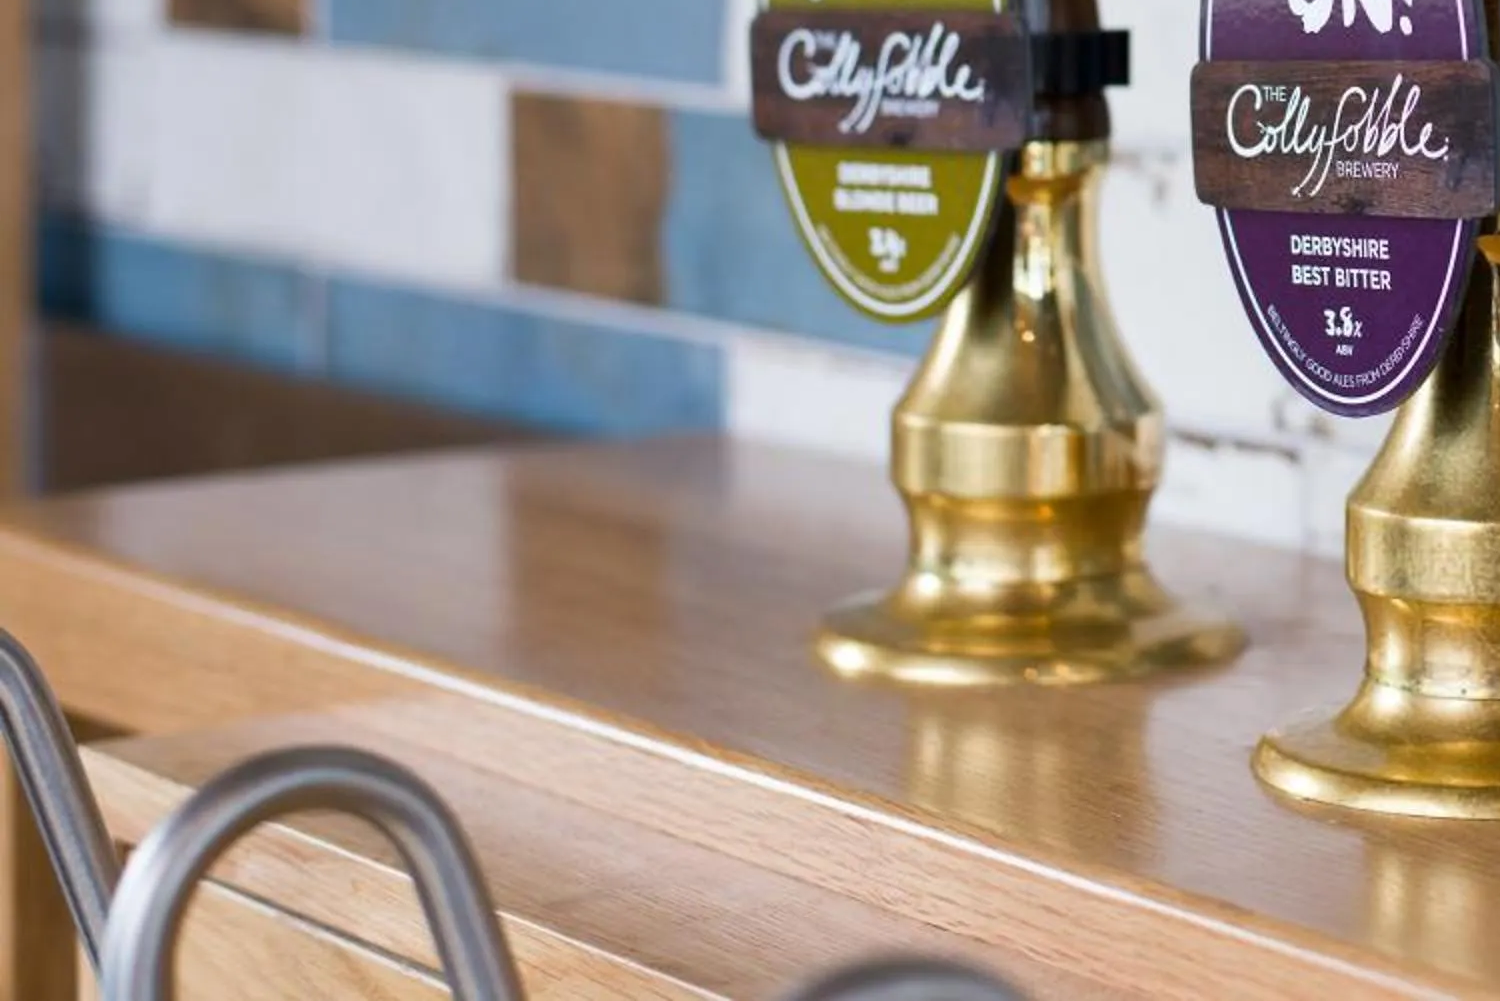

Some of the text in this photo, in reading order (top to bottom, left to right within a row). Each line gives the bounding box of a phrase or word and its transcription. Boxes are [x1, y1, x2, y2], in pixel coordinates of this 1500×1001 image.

[1262, 86, 1287, 102] THE
[1227, 73, 1449, 198] Collyfobble
[1335, 160, 1400, 180] BREWERY
[1290, 234, 1391, 260] DERBYSHIRE
[1291, 264, 1392, 290] BEST BITTER
[1306, 358, 1333, 383] GOOD
[1355, 367, 1381, 387] FROM
